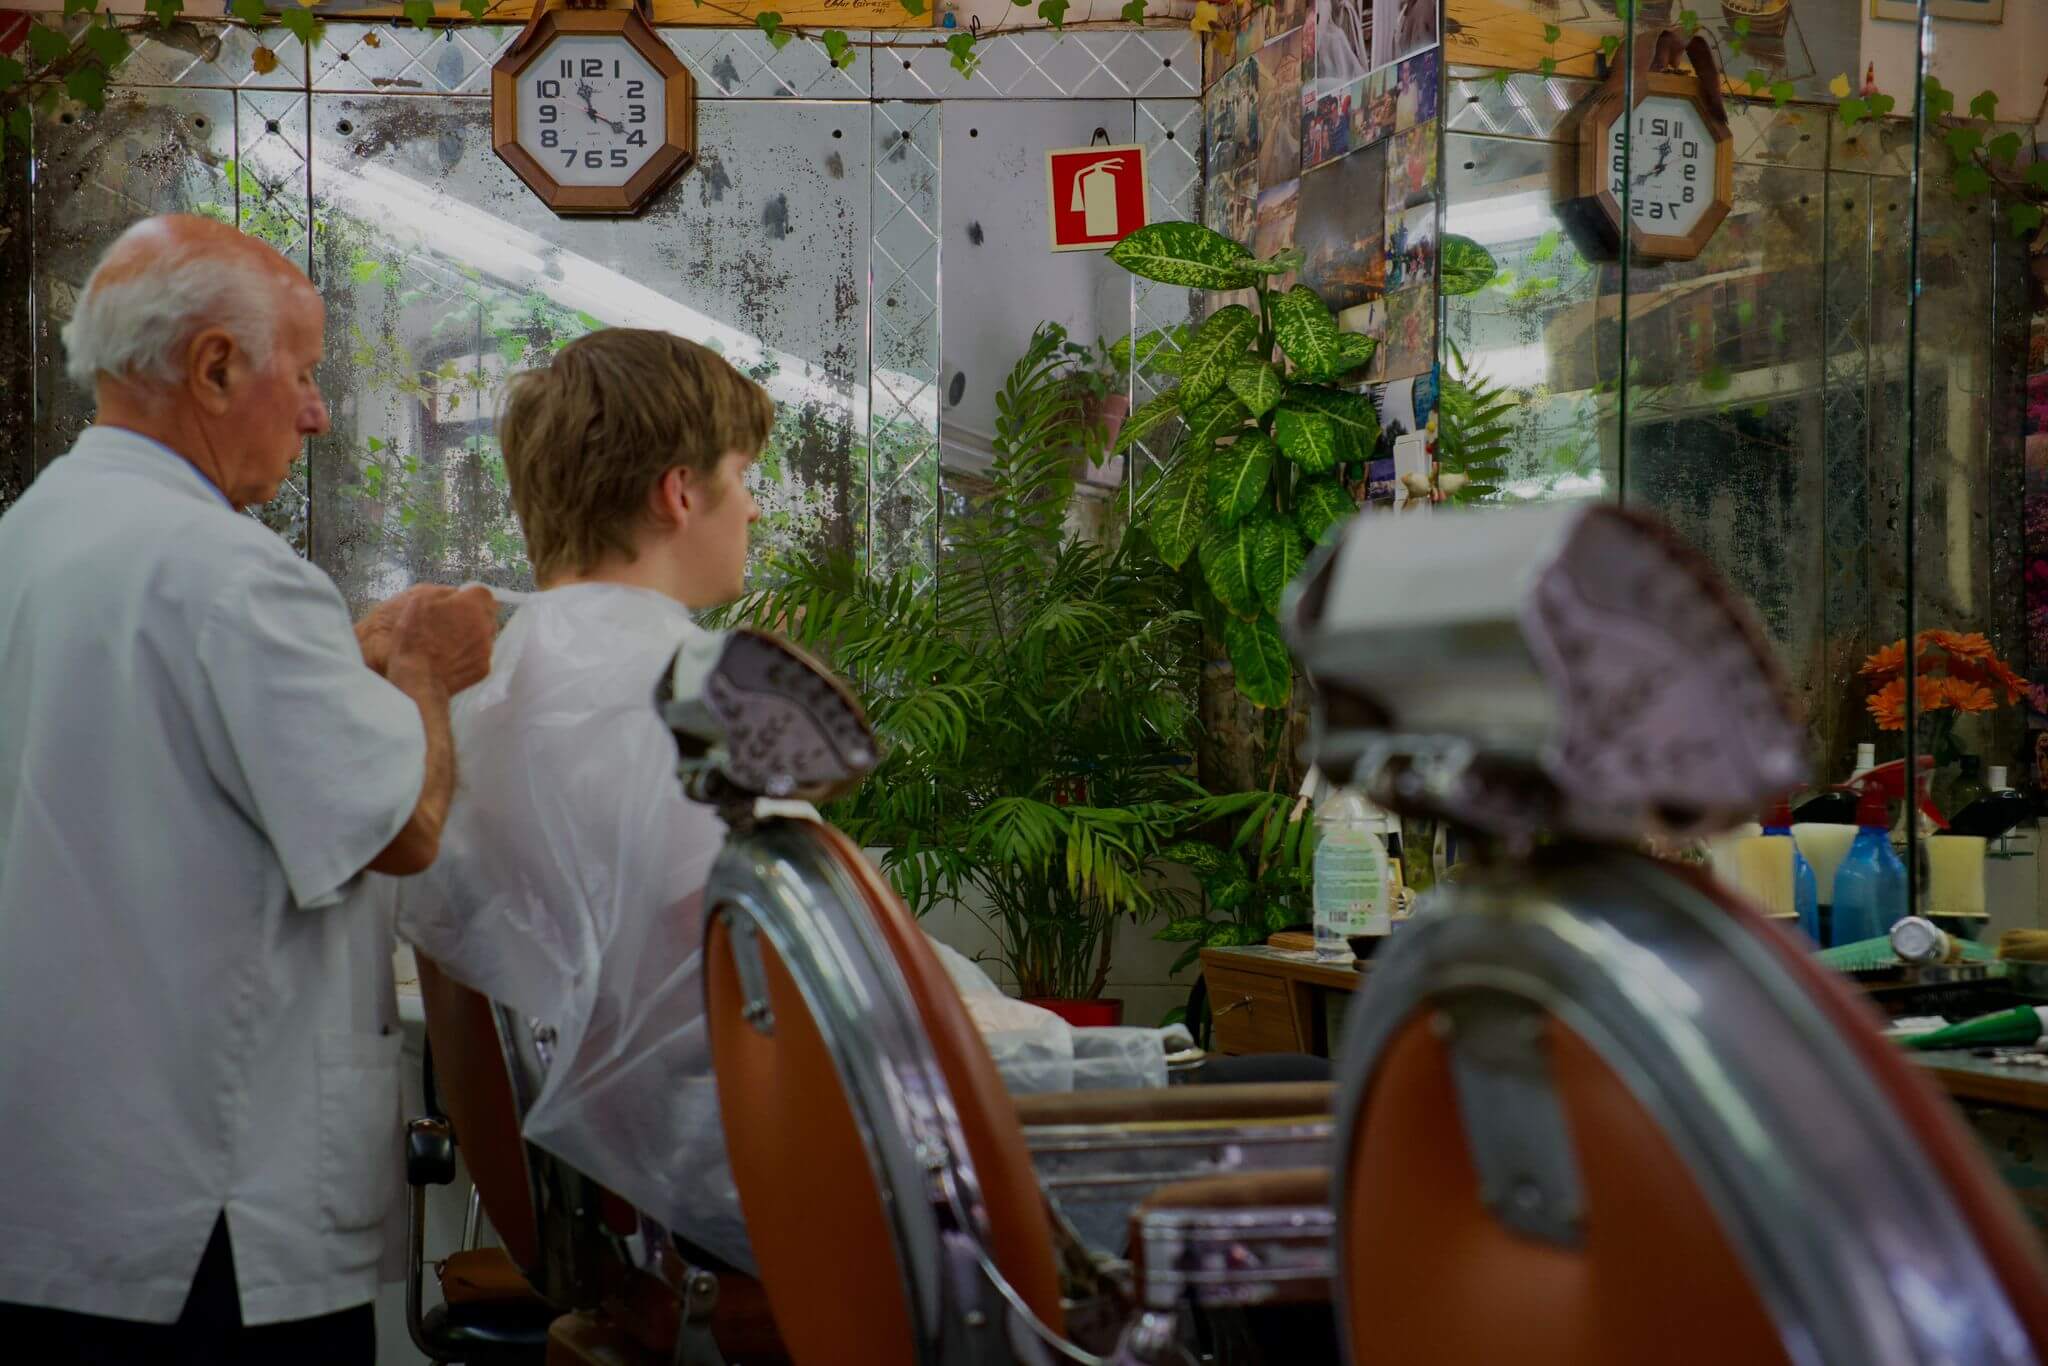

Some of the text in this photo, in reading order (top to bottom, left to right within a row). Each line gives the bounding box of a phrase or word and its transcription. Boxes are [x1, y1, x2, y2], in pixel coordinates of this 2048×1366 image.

[561, 59, 620, 78] 11 12 1
[537, 80, 560, 98] 10
[627, 80, 644, 98] 2
[539, 105, 557, 123] 9
[629, 105, 646, 123] 3
[541, 129, 559, 148] 8
[626, 129, 647, 148] 4
[560, 150, 628, 168] 7 6 5
